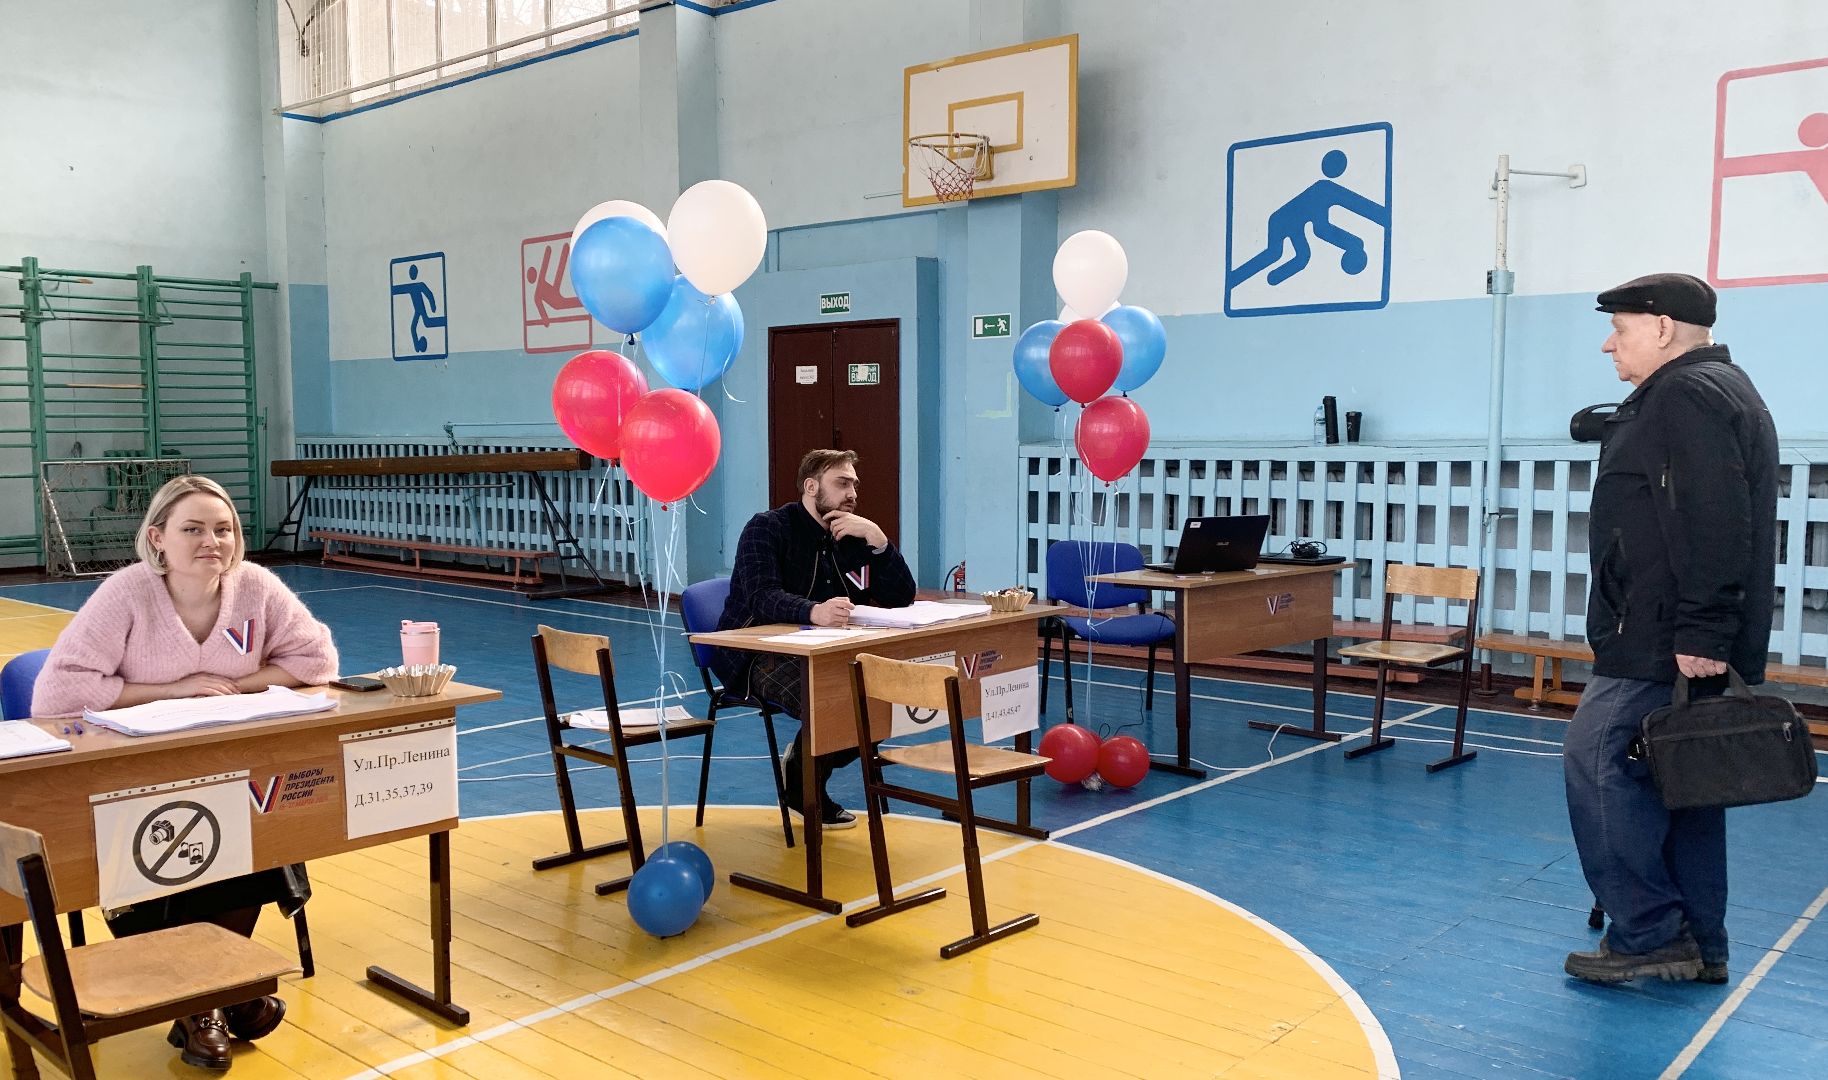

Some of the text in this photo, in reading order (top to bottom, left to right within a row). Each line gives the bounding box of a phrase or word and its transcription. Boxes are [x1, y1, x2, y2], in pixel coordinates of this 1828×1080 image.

[821, 295, 849, 310] ВЫХОД
[353, 747, 450, 772] Ул.Пр.Ленина
[288, 768, 323, 781] ВЫБОРЫ
[284, 776, 335, 792] ПРЕЗИДЕНТА
[281, 789, 313, 802] РОССИИ
[354, 782, 433, 808] Д.31,35,37,39
